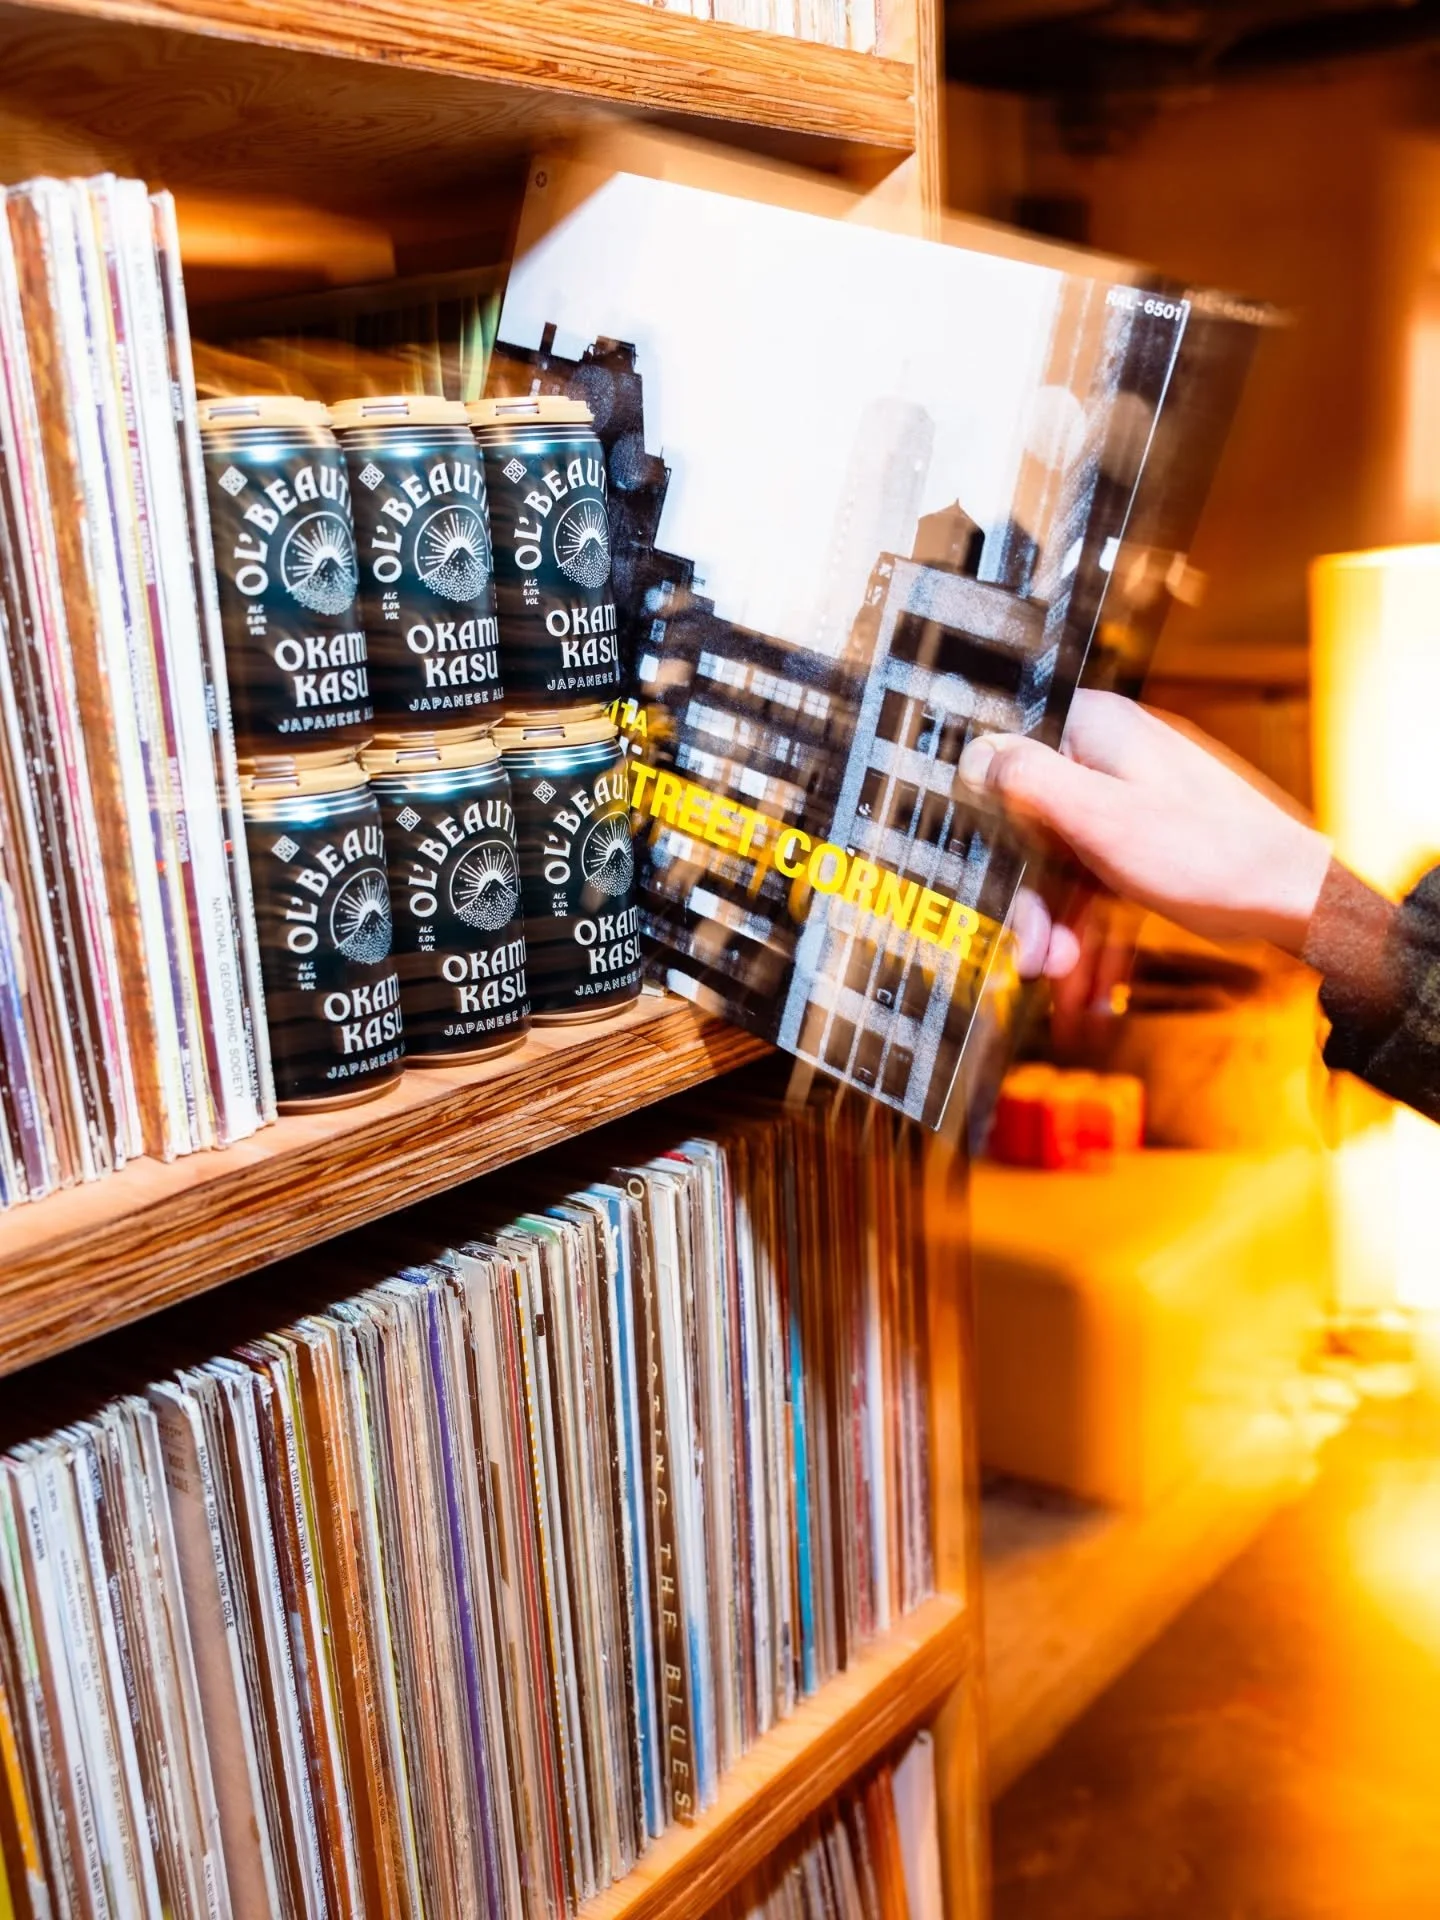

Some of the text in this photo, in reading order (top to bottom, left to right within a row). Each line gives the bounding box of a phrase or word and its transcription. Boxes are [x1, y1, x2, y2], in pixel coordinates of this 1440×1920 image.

[524, 458, 608, 518] BEAUT
[372, 525, 402, 583] OL'
[514, 516, 542, 570] OL'
[234, 533, 269, 596] OL'
[383, 592, 397, 600] ALC
[546, 603, 617, 637] OKAM
[424, 651, 499, 688] KASU
[561, 634, 619, 668] KASU
[293, 667, 369, 707] KASU
[409, 691, 488, 711] JAPANESE
[547, 672, 613, 691] JAPANESE
[278, 710, 361, 733] JAPANESE
[604, 699, 648, 738] ITA
[553, 774, 630, 836] BEAUT
[544, 833, 571, 884] OL'
[629, 760, 980, 960] TREET CORNER
[286, 825, 387, 954] OL' BEAUT
[408, 863, 438, 917] OL'
[553, 892, 566, 900] ALC
[574, 905, 640, 945] OKAM
[210, 896, 244, 1098] NATIONAL GEOGRAPHIC SOCIETY
[300, 982, 316, 990] VOL
[324, 972, 400, 1022] OKAM
[459, 970, 527, 1014] KASU
[575, 970, 637, 996] JAPANESE
[341, 1004, 403, 1055] KASU
[444, 1011, 518, 1036] JAPANESE
[327, 1048, 399, 1079] JAPANESE
[206, 1501, 218, 1531] ROSE
[290, 1469, 303, 1522] DRATEWKA
[302, 1557, 313, 1584] BAJKI
[213, 1543, 223, 1565] NAT
[216, 1570, 228, 1596] KING
[659, 1543, 678, 1629] THE
[222, 1599, 234, 1628] COLE
[665, 1663, 693, 1807] BLUES
[74, 1764, 88, 1817] LAWRENCE
[91, 1870, 102, 1894] BEST
[96, 1896, 104, 1908] OF
